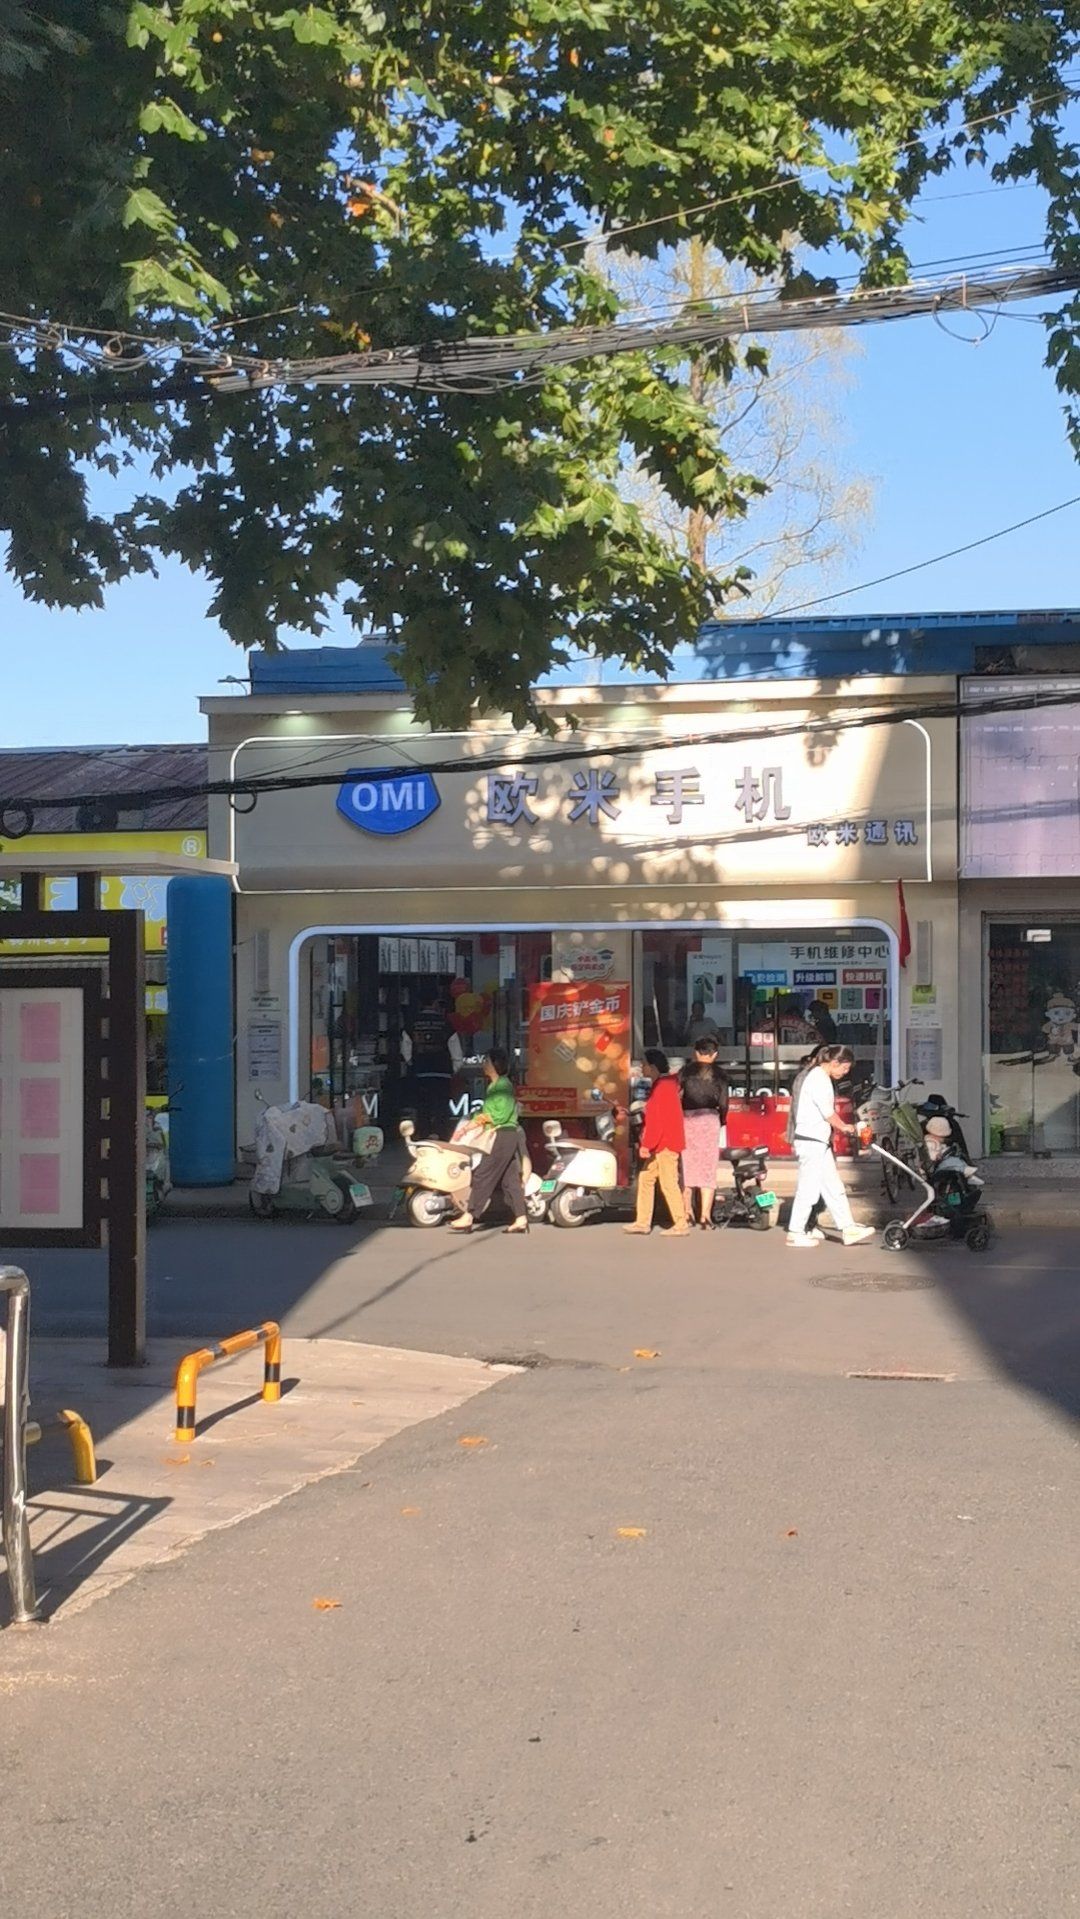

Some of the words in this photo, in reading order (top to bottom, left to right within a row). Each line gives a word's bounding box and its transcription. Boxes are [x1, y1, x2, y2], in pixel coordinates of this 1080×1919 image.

[352, 782, 425, 812] OMI
[486, 766, 792, 826] 欧米手机
[806, 820, 918, 846] 欧米通讯
[790, 944, 890, 959] 手机维修中心
